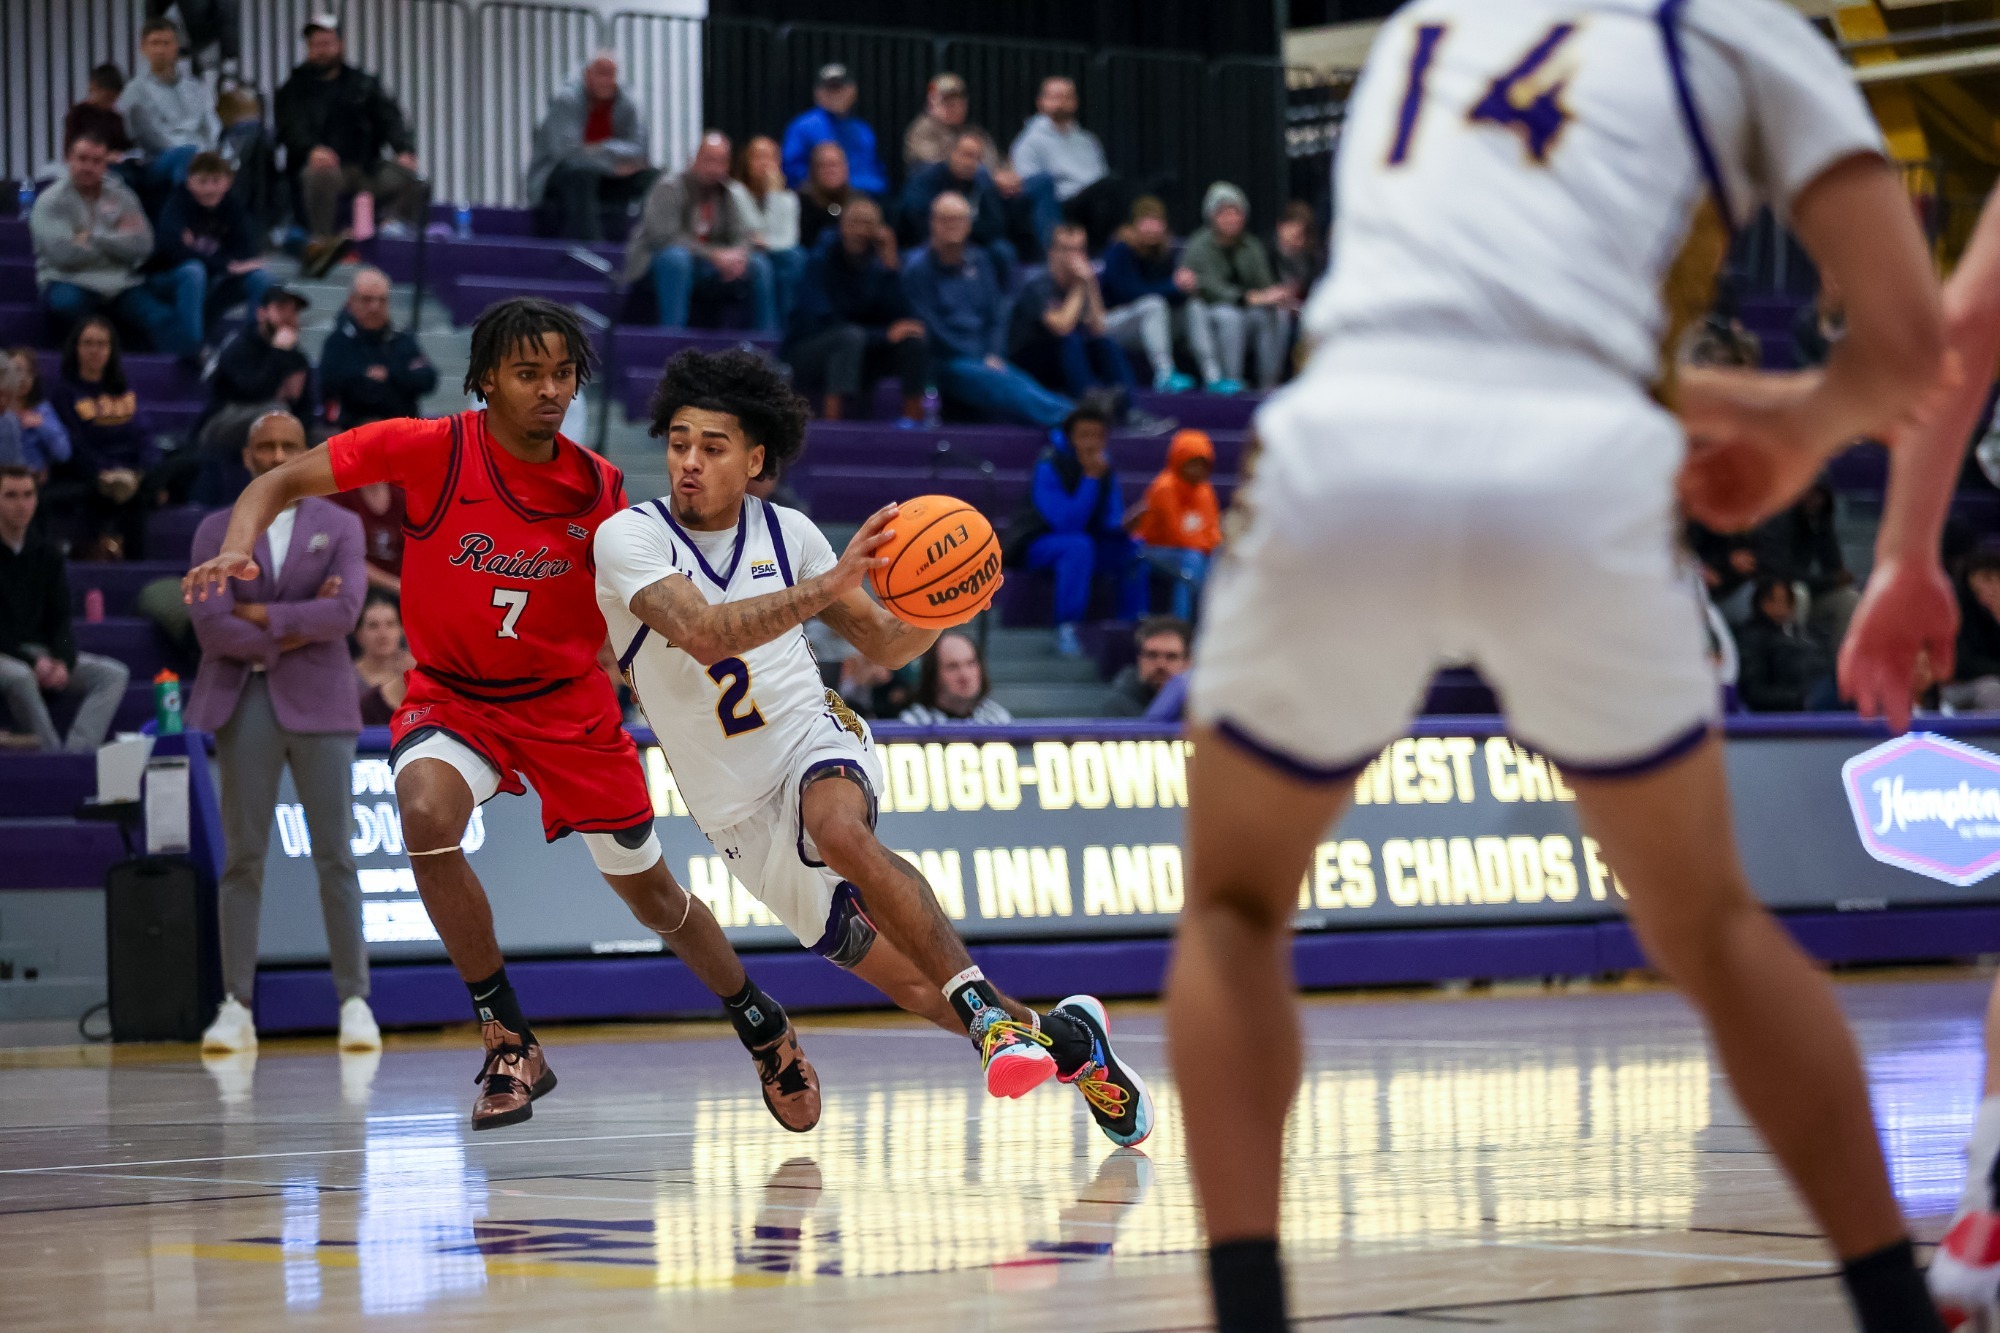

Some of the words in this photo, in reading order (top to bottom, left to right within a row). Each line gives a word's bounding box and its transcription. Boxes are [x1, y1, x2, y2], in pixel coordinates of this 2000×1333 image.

[1386, 22, 1574, 166] 14
[449, 533, 573, 580] Raiders
[751, 563, 777, 575] PSAC
[926, 553, 999, 606] Wilson
[491, 586, 531, 640] 7
[705, 655, 768, 739] 2
[972, 845, 1073, 919] INN
[1083, 843, 1186, 916] AND
[1382, 835, 1579, 907] CHADDS
